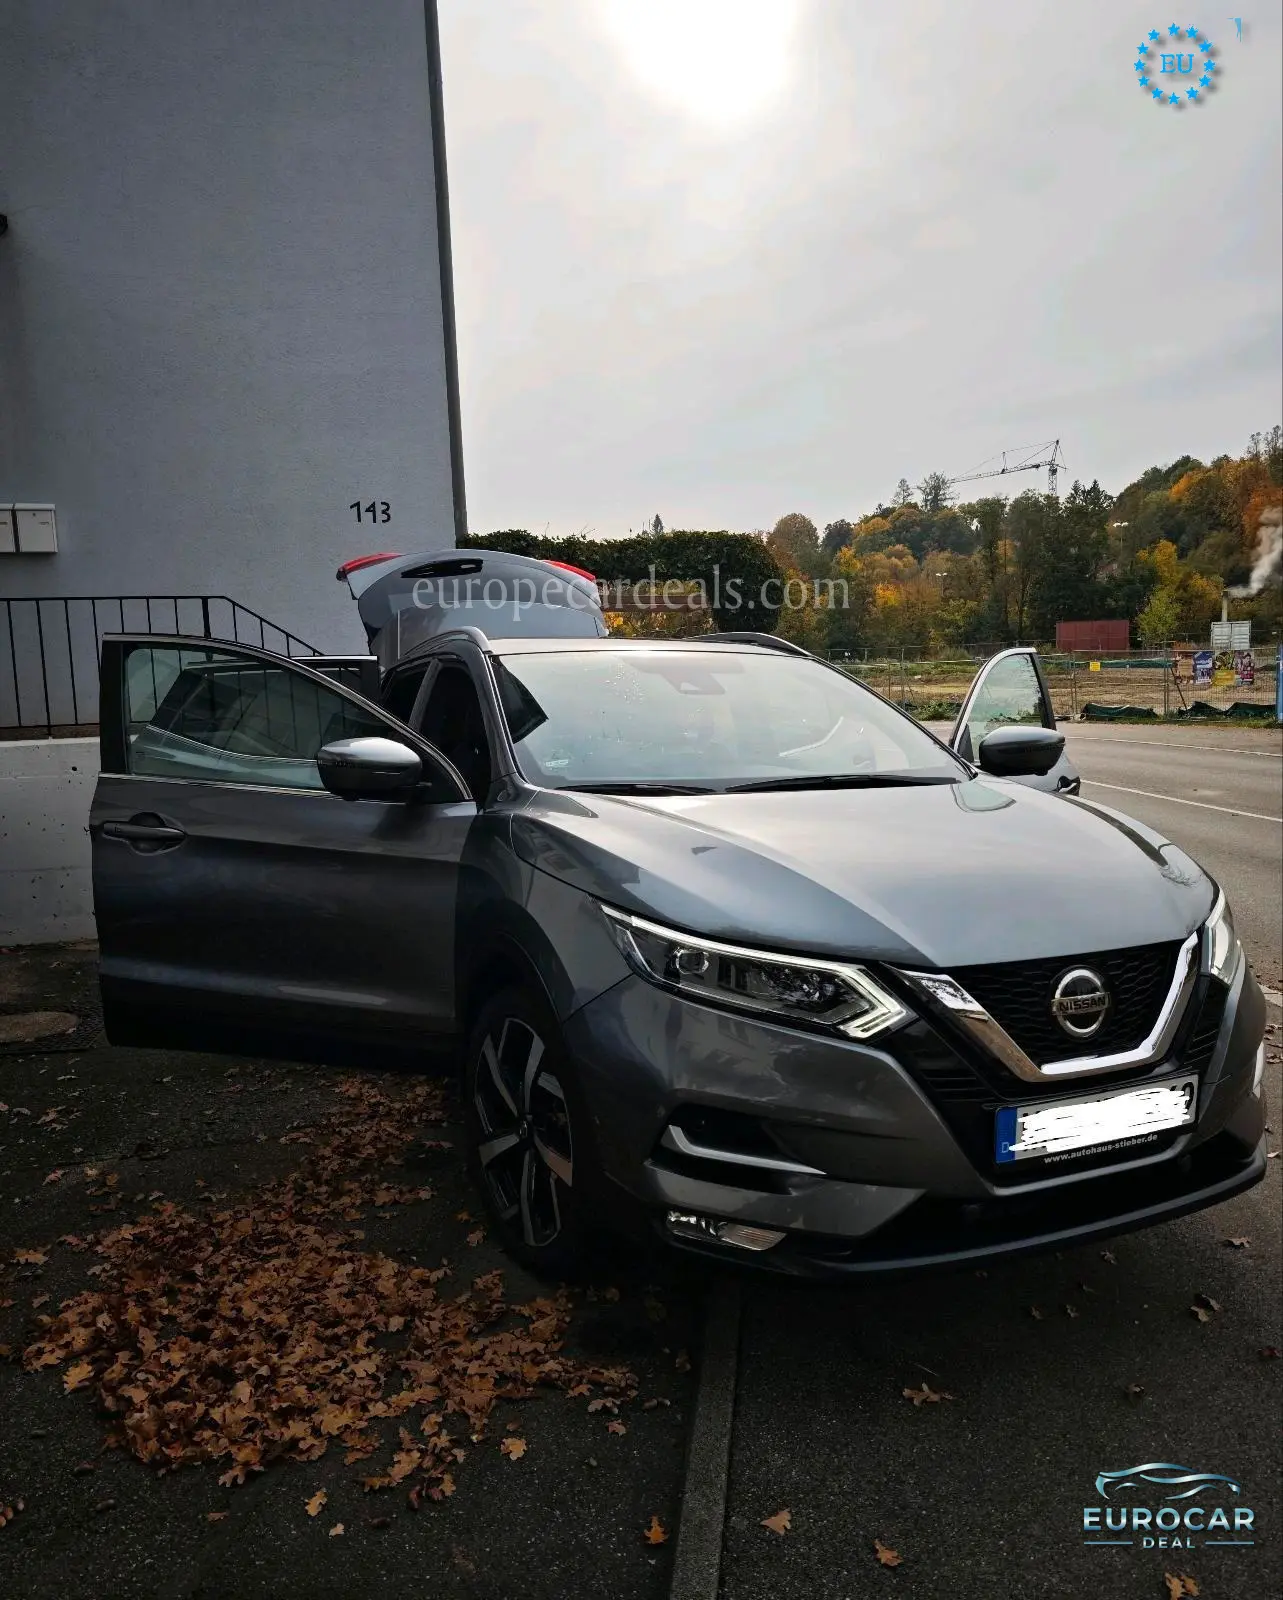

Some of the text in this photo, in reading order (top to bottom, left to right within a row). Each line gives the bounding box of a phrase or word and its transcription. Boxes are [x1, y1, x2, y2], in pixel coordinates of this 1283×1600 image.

[349, 500, 391, 524] 143
[1058, 995, 1106, 1012] NISSAN
[1043, 1133, 1158, 1164] www.autohaus-stieber.de
